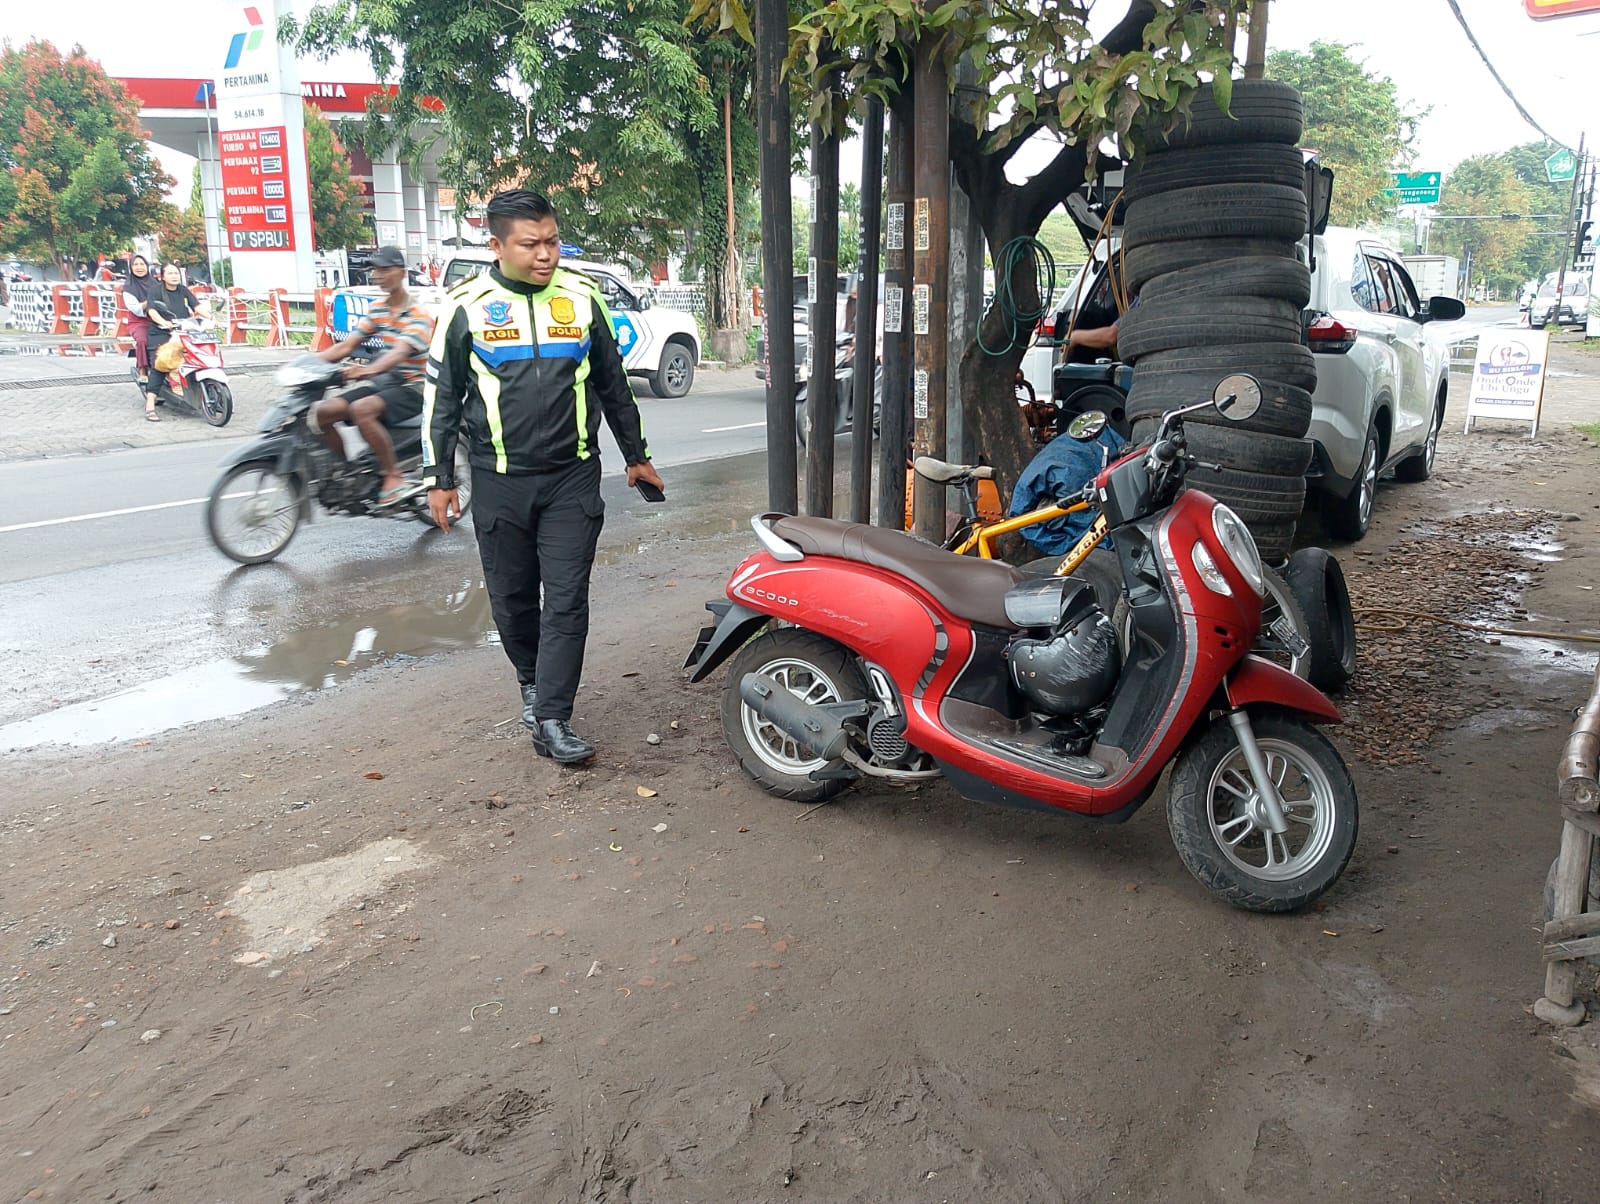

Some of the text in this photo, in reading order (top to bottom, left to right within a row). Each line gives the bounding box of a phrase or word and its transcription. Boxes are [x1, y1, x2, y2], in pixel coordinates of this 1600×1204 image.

[224, 73, 269, 88] PERTAMINA
[222, 131, 256, 142] PERTAMAX
[224, 157, 258, 167] PERTAMAX
[226, 186, 258, 196] PERTALITE
[228, 205, 265, 215] PERTAMINA
[229, 216, 243, 225] DEX
[249, 231, 283, 248] SPBU
[485, 330, 519, 339] AGIL
[549, 327, 580, 336] POLRI
